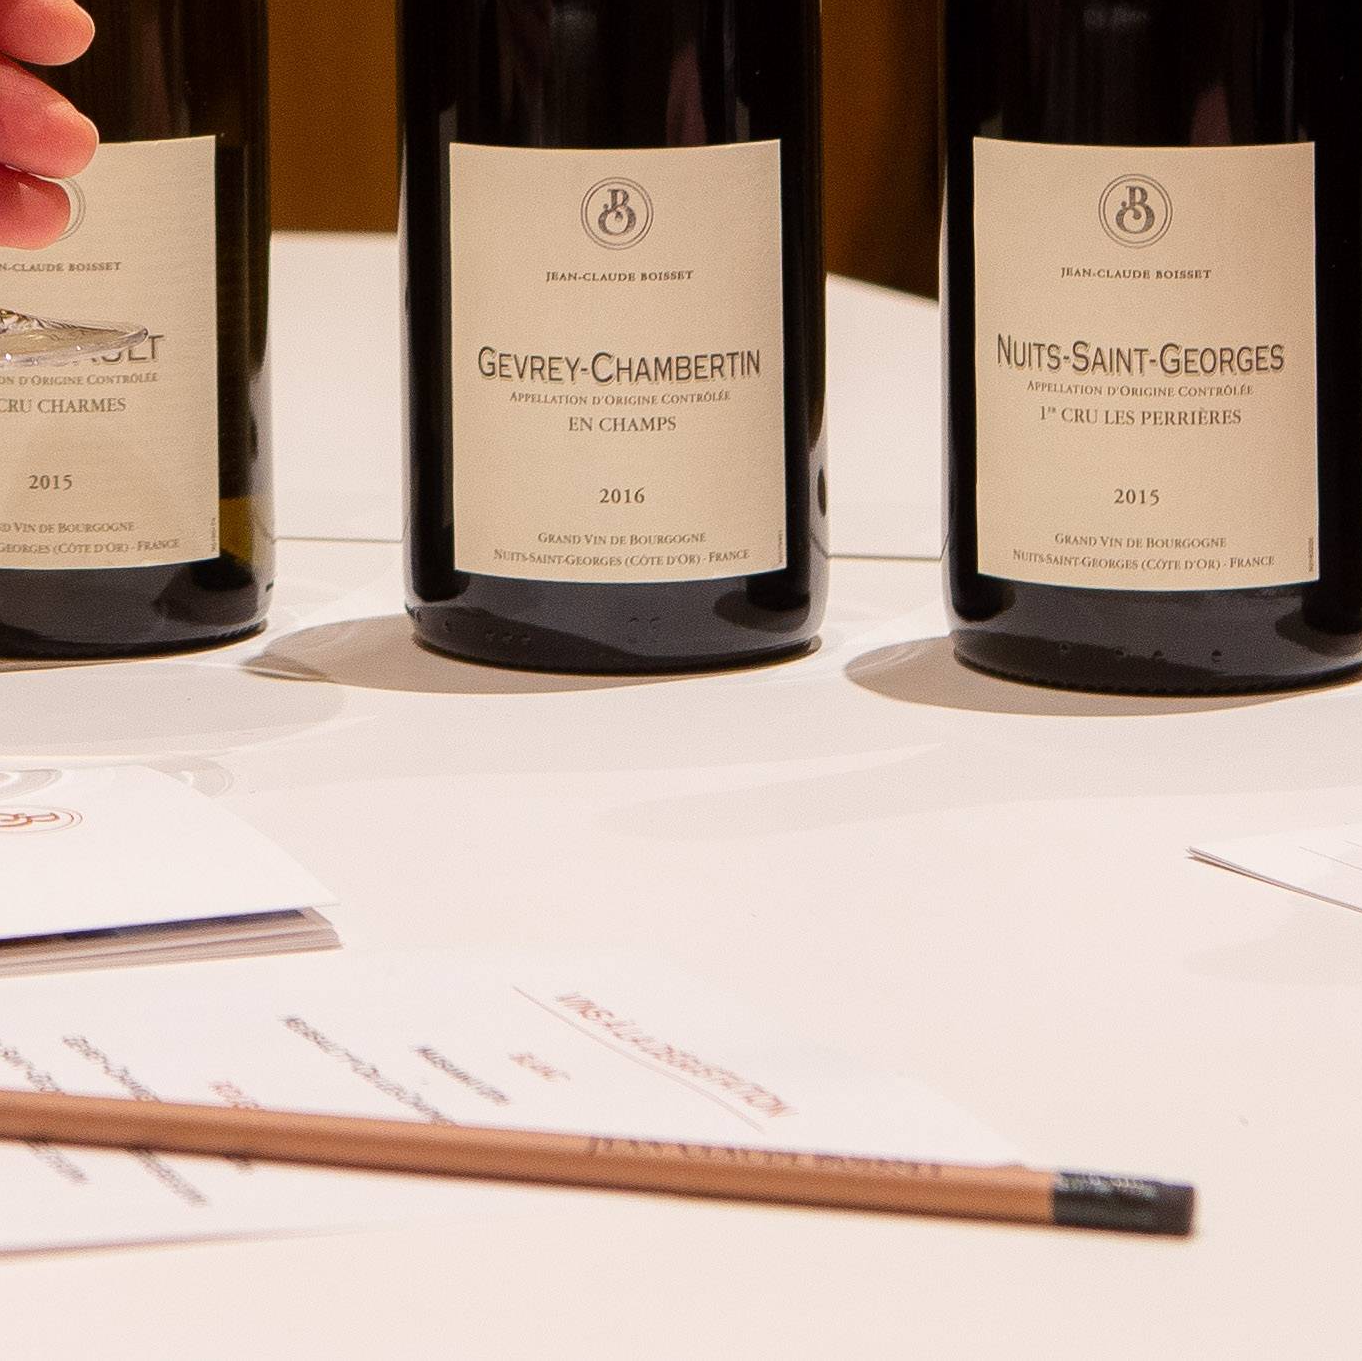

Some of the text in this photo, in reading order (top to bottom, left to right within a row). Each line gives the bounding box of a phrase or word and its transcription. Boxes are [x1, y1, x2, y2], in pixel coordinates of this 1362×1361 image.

[68, 261, 122, 272] BOISSET
[1060, 267, 1212, 280] JEAN-CLAUDE BOISSET
[546, 269, 694, 282] JEAN-CLAUDE BOISSET
[997, 333, 1286, 374] NUITS-SAINT-GEORGES
[477, 345, 761, 383] GEVREY-CHAMBERTIN
[1027, 380, 1103, 395] APPELLATION
[1107, 384, 1175, 398] D'ORIGINE
[37, 397, 127, 413] CHARMES
[509, 390, 588, 406] APPELLATION
[592, 394, 657, 406] D'ORIGINE
[568, 416, 677, 432] EN CHAMPS
[1061, 407, 1099, 424] CRU
[1104, 409, 1135, 425] LES
[1141, 406, 1242, 426] PERRIÈRES
[28, 474, 73, 490] 2015
[599, 487, 646, 504] 2016
[1113, 488, 1160, 506] 2015
[57, 520, 135, 534] BOURGOGNE
[538, 532, 706, 546] GRAND VIN DE BOURGOGNE
[1054, 533, 1227, 549] GRAND VIN DE BOURGOGNE
[708, 548, 750, 563] FRANCE
[1229, 555, 1275, 569] FRANCE
